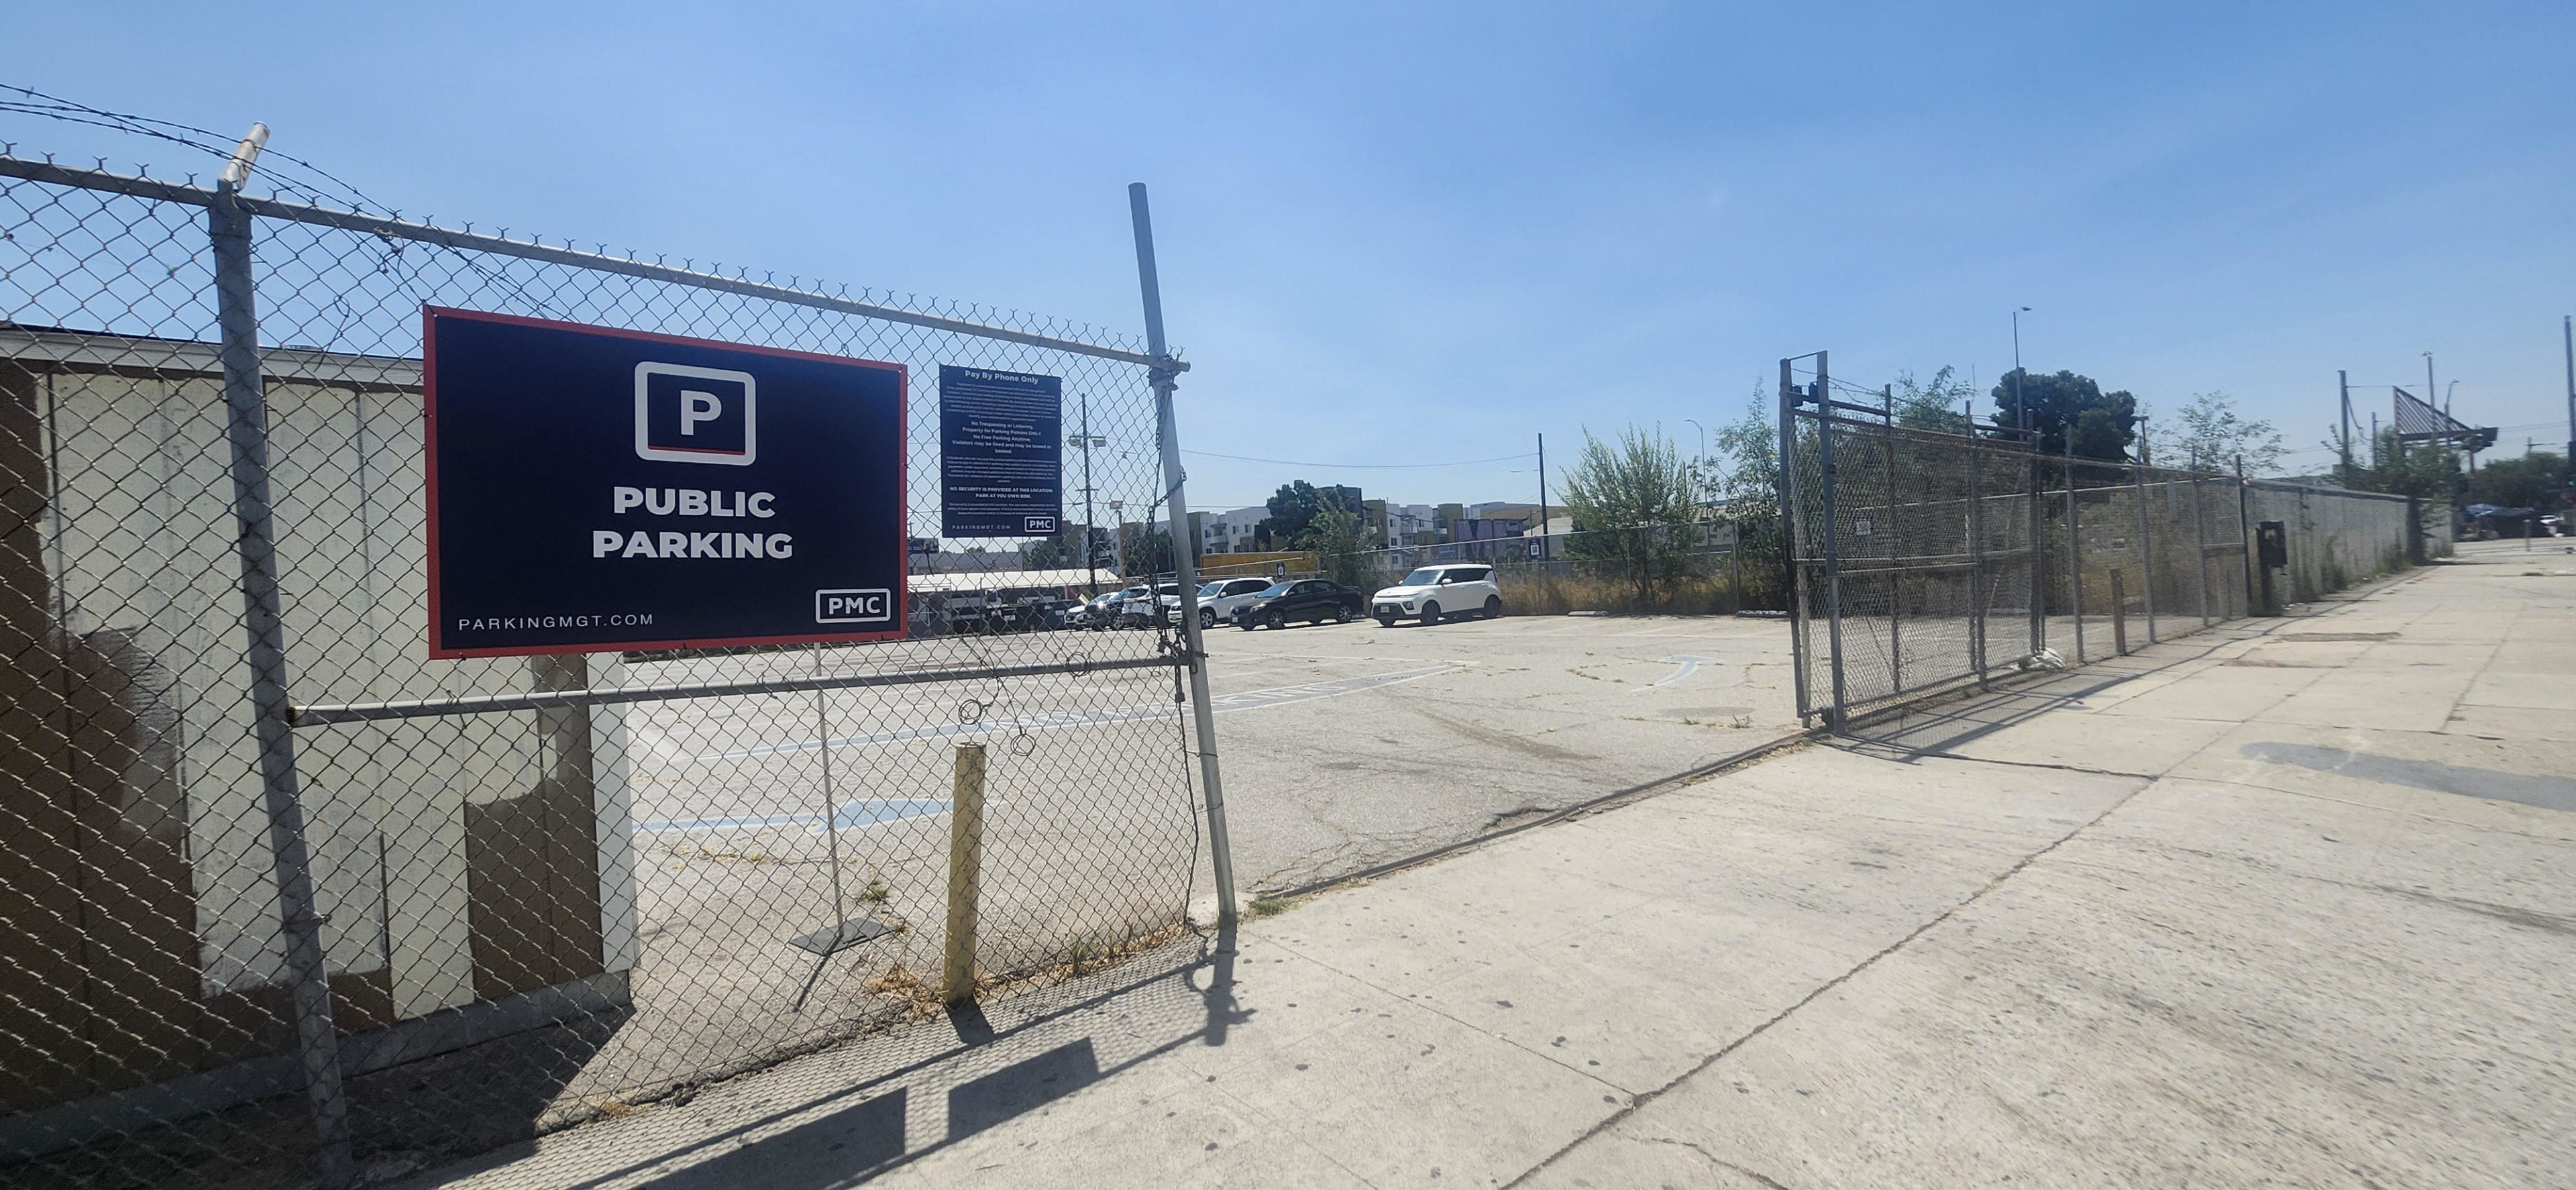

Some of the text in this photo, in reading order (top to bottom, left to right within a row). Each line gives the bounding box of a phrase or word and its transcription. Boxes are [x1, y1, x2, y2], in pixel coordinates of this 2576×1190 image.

[965, 370, 1038, 385] Pay By Phone Only
[681, 390, 721, 435] P
[614, 487, 775, 517] PUBLIC
[1030, 520, 1051, 529] PMC
[594, 531, 792, 558] PARKING
[829, 597, 880, 614] PMC
[460, 614, 651, 630] PARKINGMGT.COM
